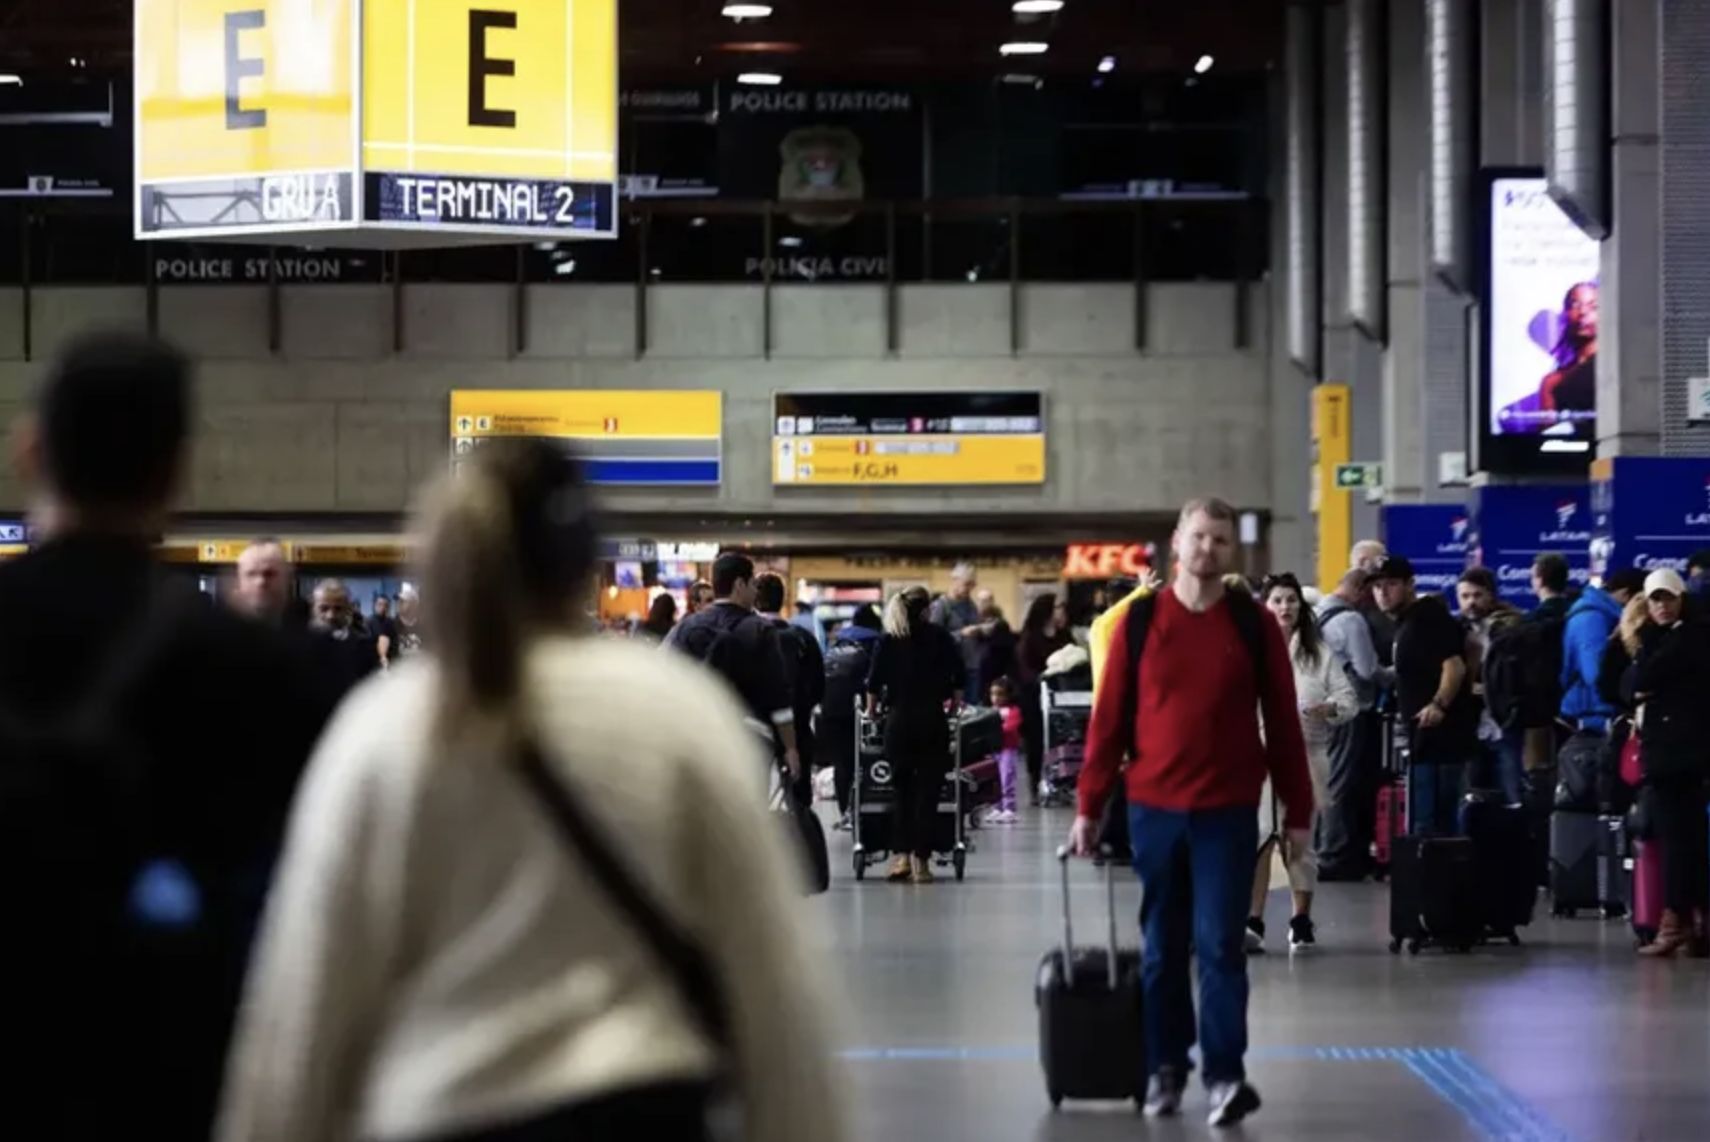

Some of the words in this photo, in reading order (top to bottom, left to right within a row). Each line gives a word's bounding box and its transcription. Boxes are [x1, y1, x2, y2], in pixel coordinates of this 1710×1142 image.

[224, 9, 267, 130] E
[467, 8, 517, 128] E
[730, 91, 805, 111] POLICE
[815, 92, 910, 110] STATION
[262, 175, 315, 221] GRU
[397, 178, 548, 222] TERMINAL
[554, 186, 574, 223] 2
[155, 258, 233, 278] POLICE
[244, 258, 341, 278] STATION
[1063, 543, 1147, 577] KFC
